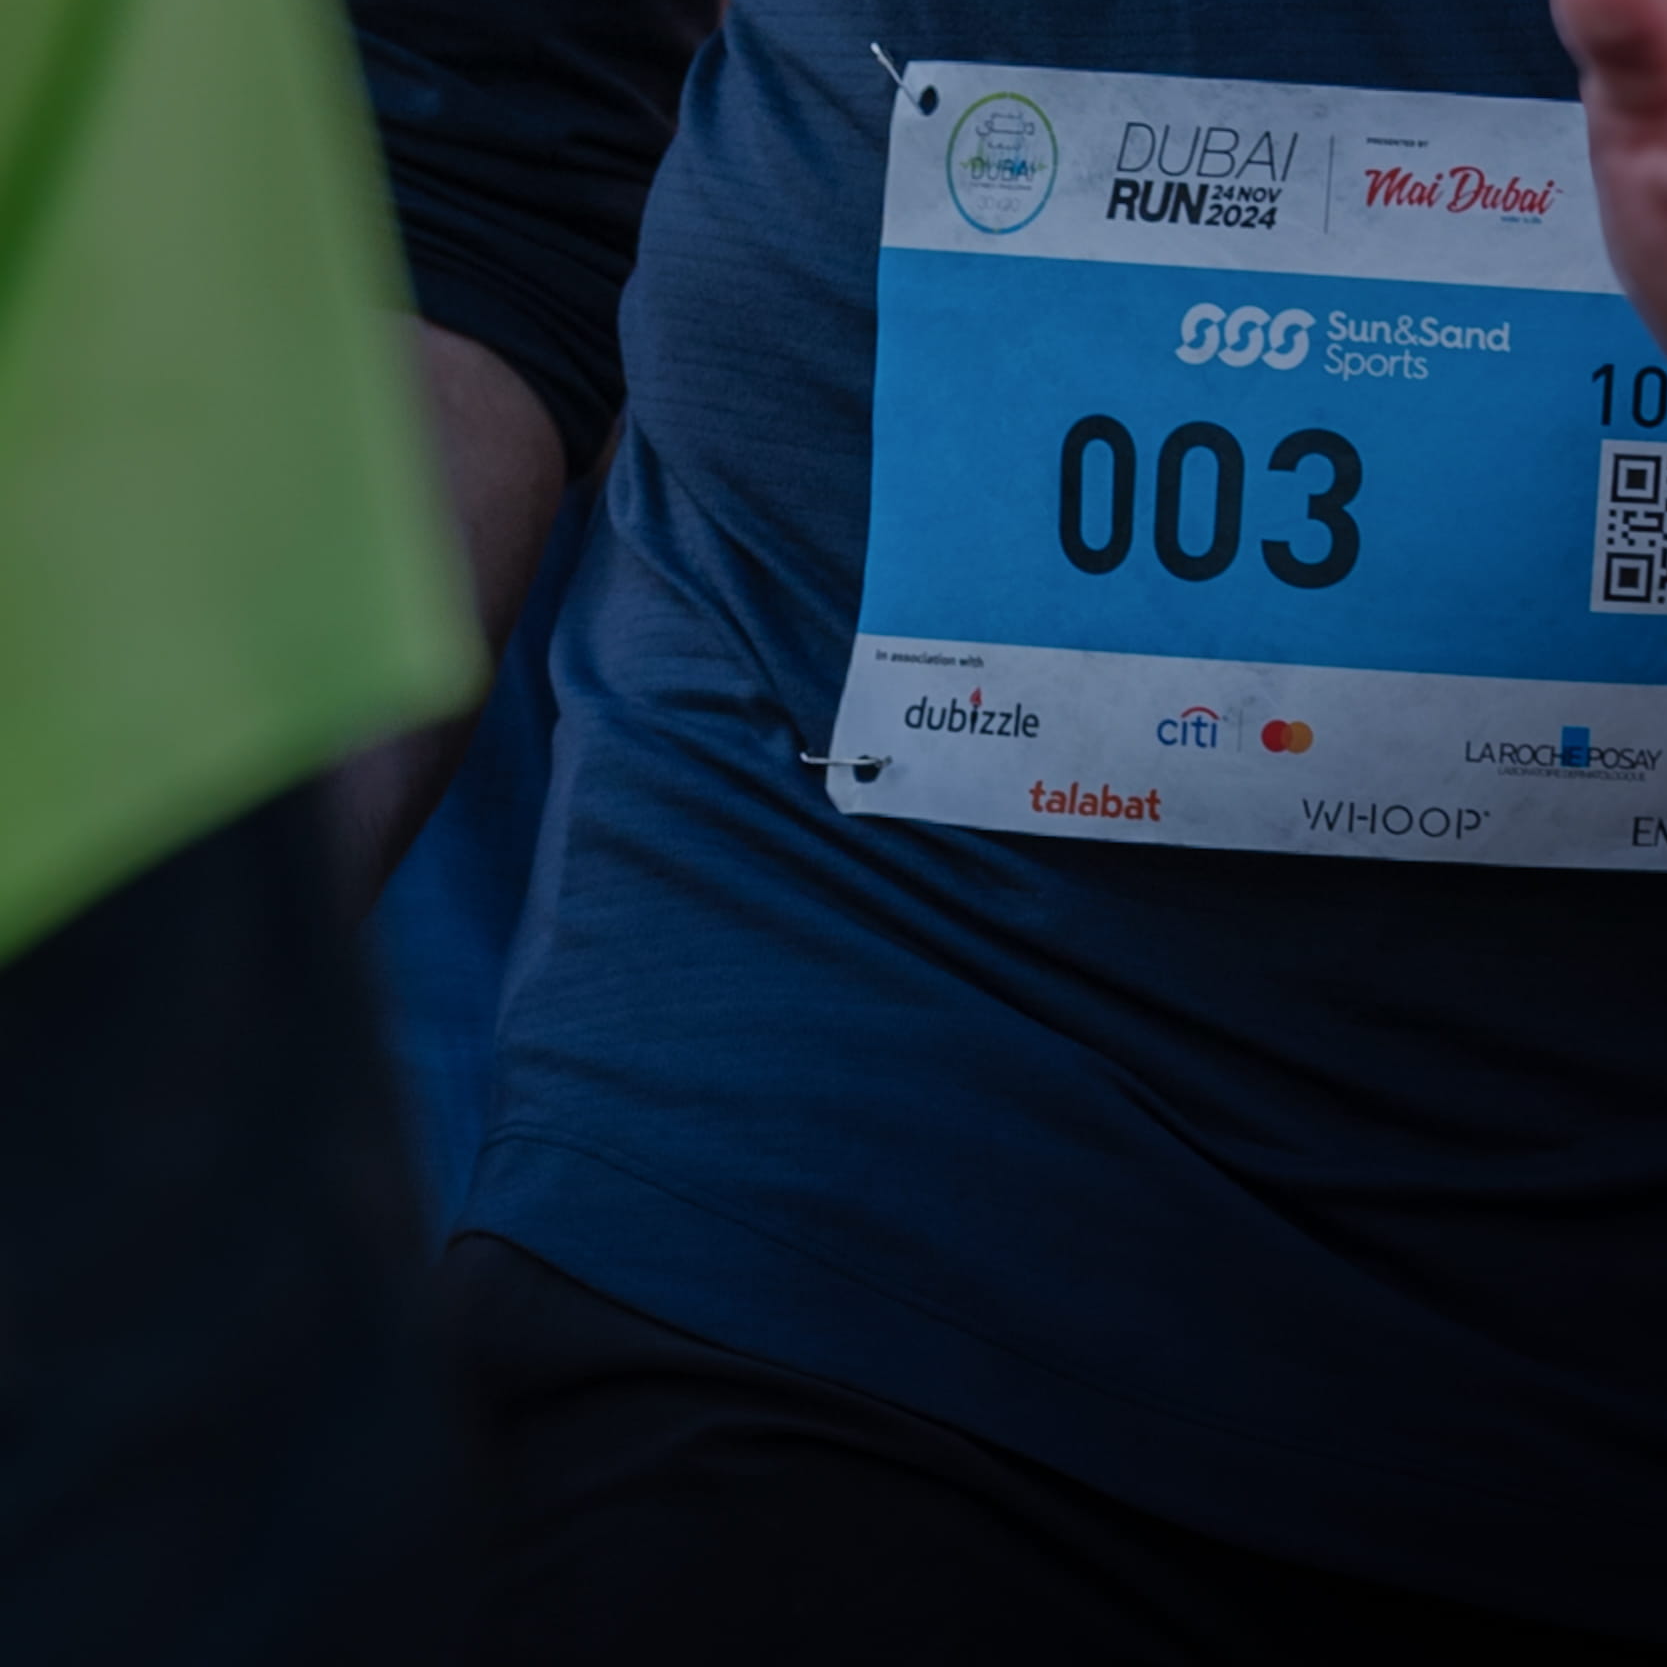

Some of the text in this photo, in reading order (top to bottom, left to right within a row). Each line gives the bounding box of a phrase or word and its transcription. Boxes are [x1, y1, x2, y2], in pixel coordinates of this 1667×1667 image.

[1116, 121, 1299, 182] DUBAI
[1106, 178, 1210, 225] RUN
[1211, 185, 1283, 203] 24 NOV
[1364, 165, 1556, 215] Mai Dubai
[1204, 204, 1278, 230] 2024
[1326, 310, 1512, 352] Sun&Sand
[1323, 343, 1429, 381] Sports
[1057, 413, 1364, 590] 003
[904, 689, 1040, 739] dubizzle
[1156, 707, 1219, 748] citi
[1465, 740, 1496, 763] LA
[1029, 779, 1162, 822] talabat
[1302, 797, 1481, 839] WHOOP
